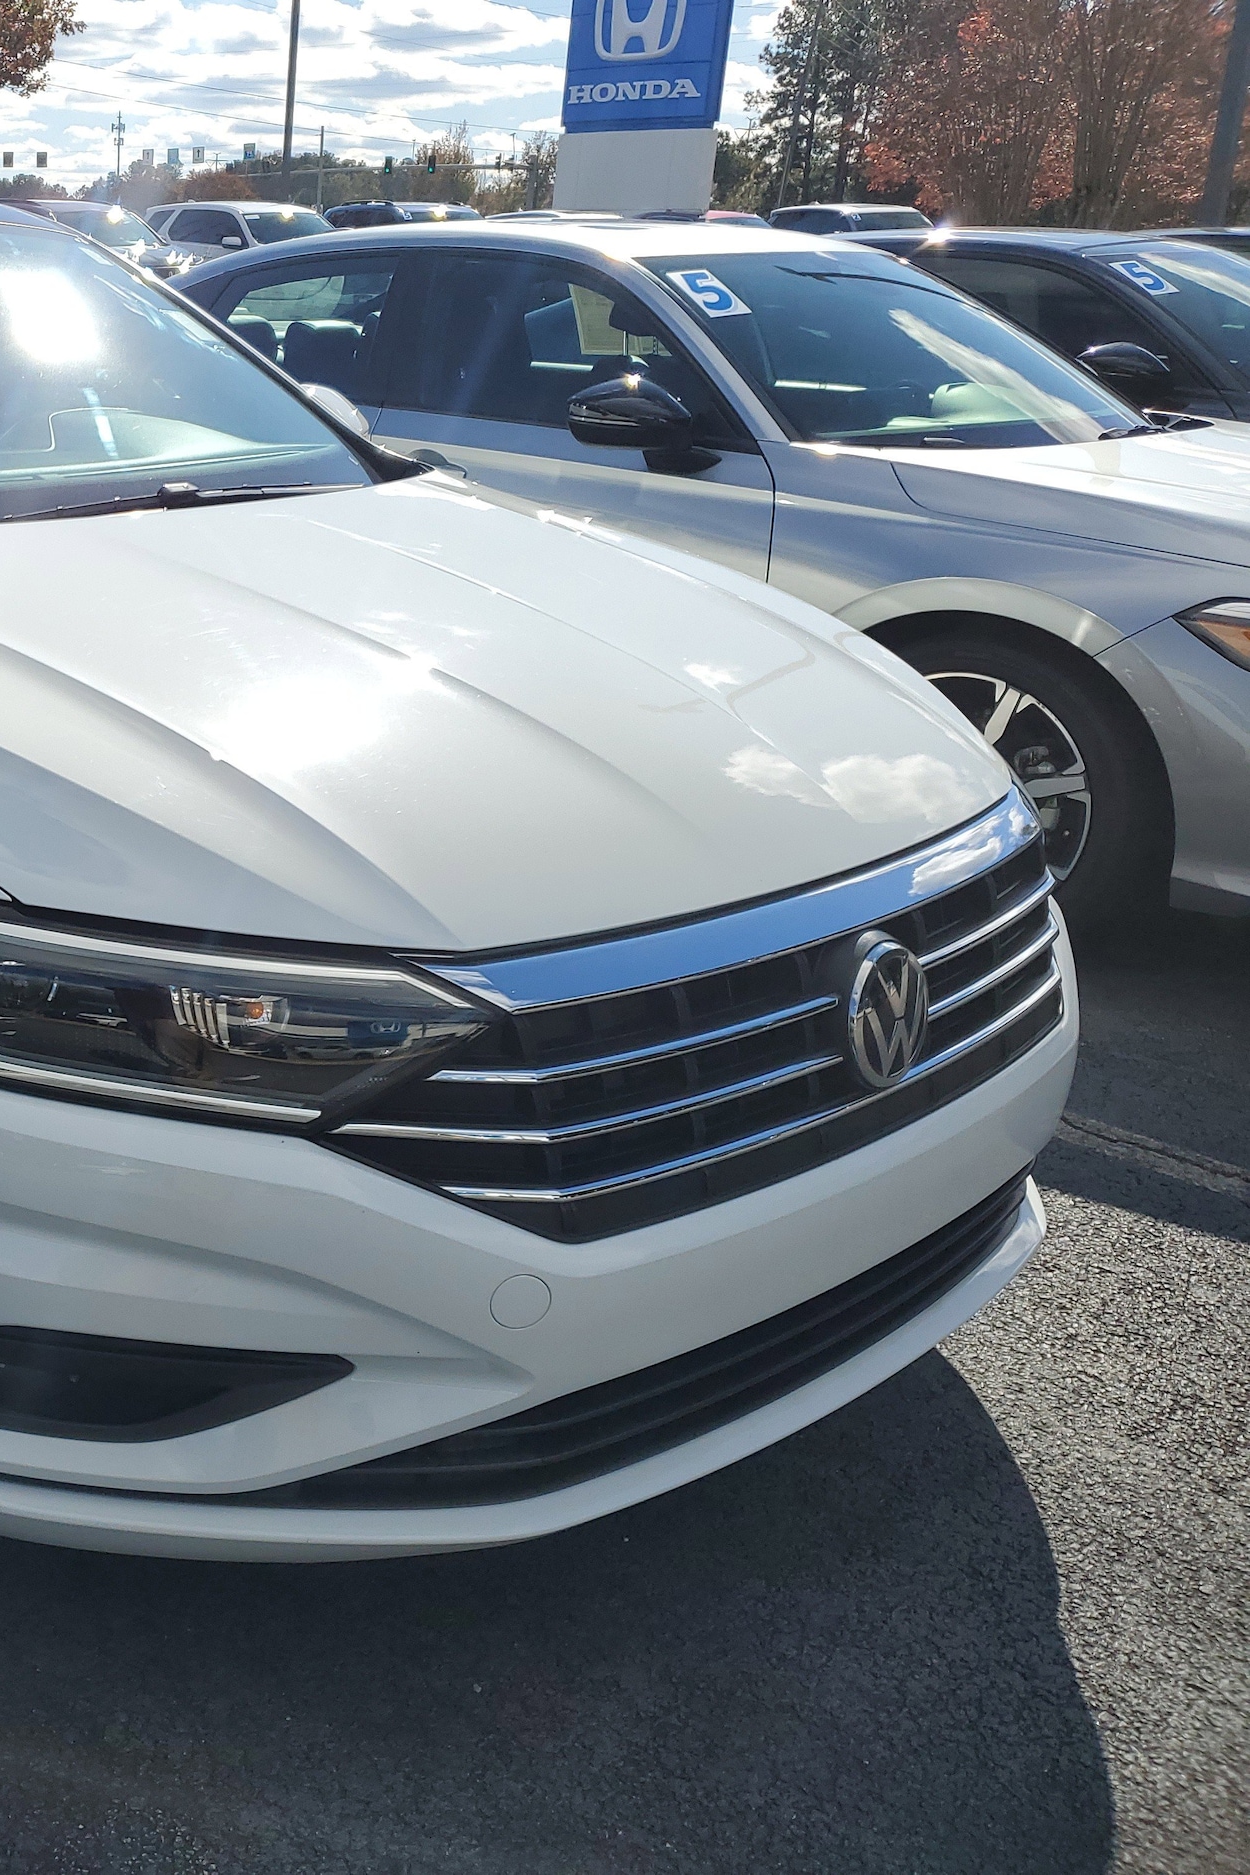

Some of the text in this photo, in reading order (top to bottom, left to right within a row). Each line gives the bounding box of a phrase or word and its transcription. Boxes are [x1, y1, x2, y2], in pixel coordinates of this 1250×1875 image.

[567, 78, 701, 104] HONDA
[1120, 262, 1165, 290] 5
[680, 272, 734, 311] 5
